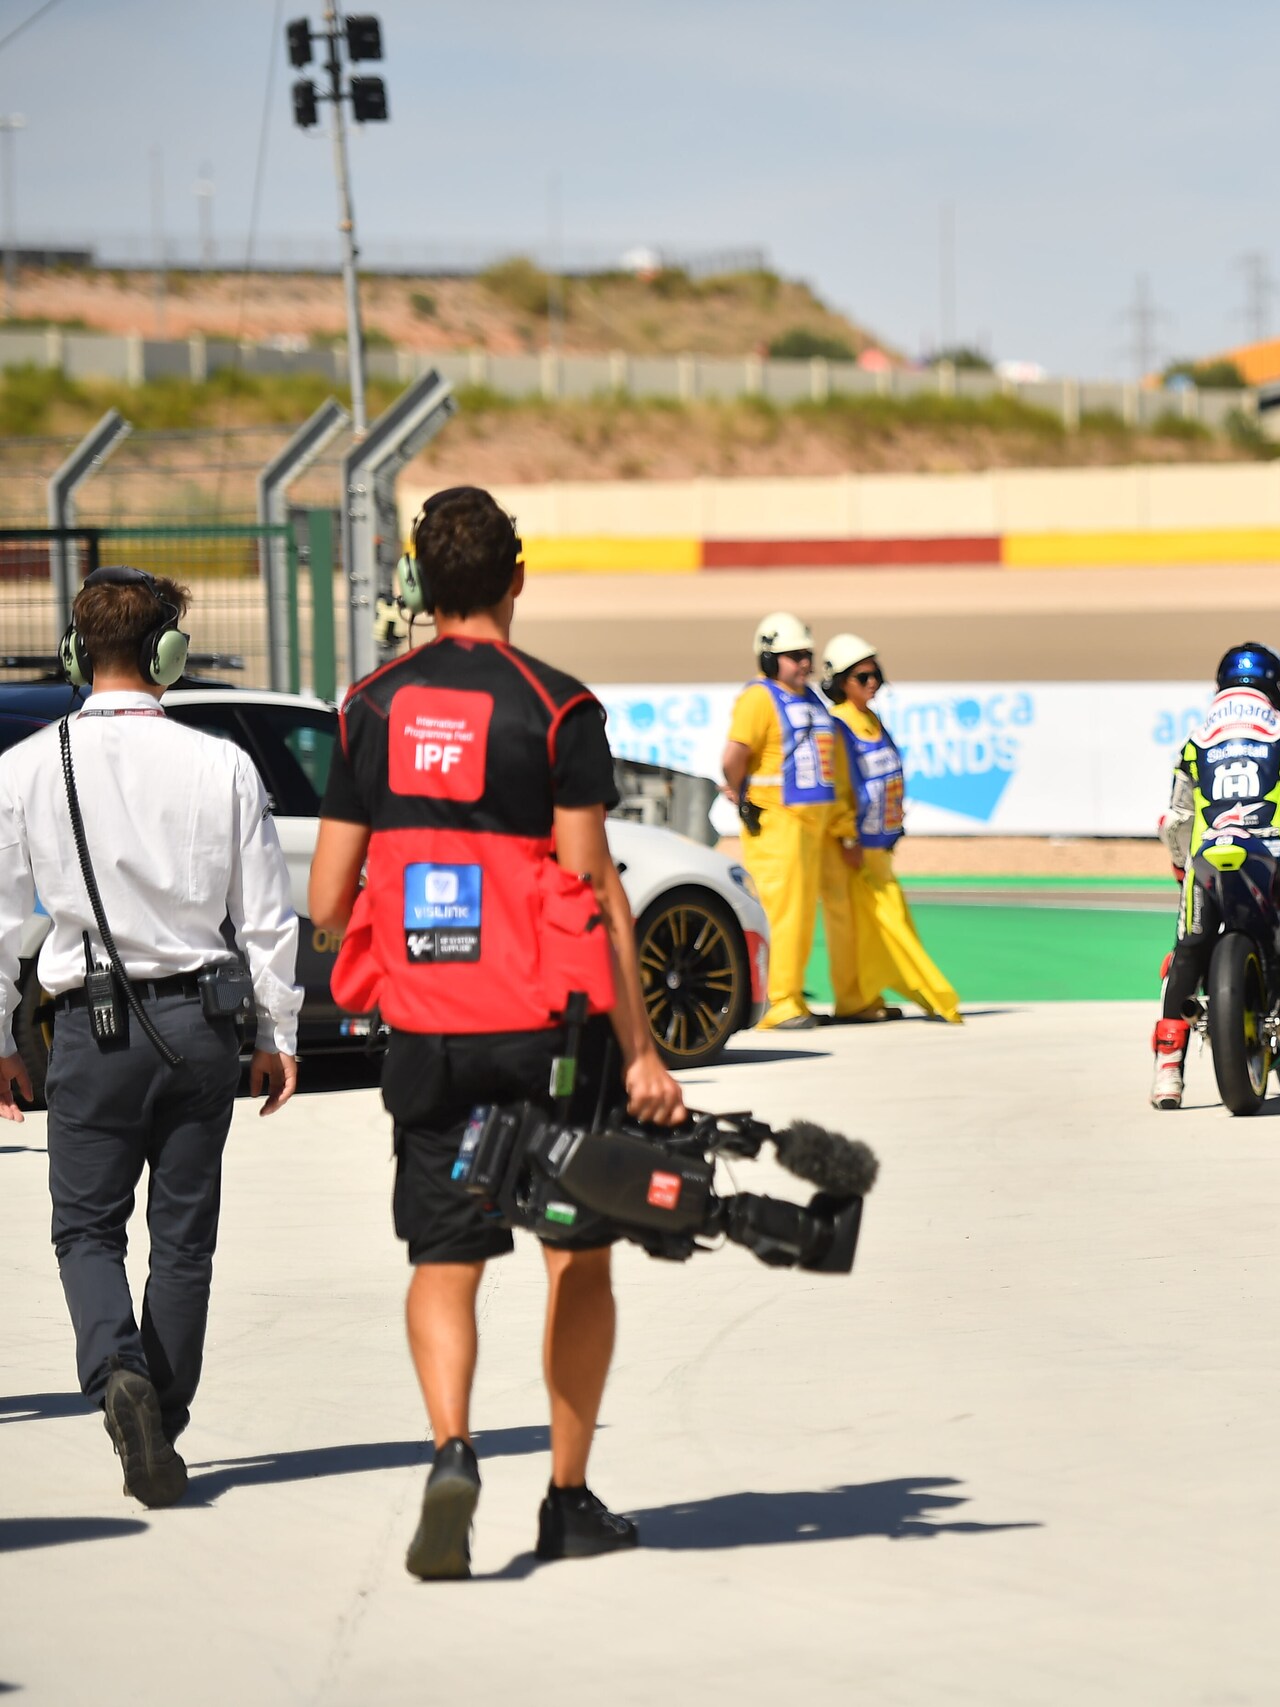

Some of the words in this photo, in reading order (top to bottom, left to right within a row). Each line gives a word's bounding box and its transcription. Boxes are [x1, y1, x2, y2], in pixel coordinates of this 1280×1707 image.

[415, 715, 466, 730] International
[404, 725, 452, 740] Programme
[415, 744, 463, 774] IPF
